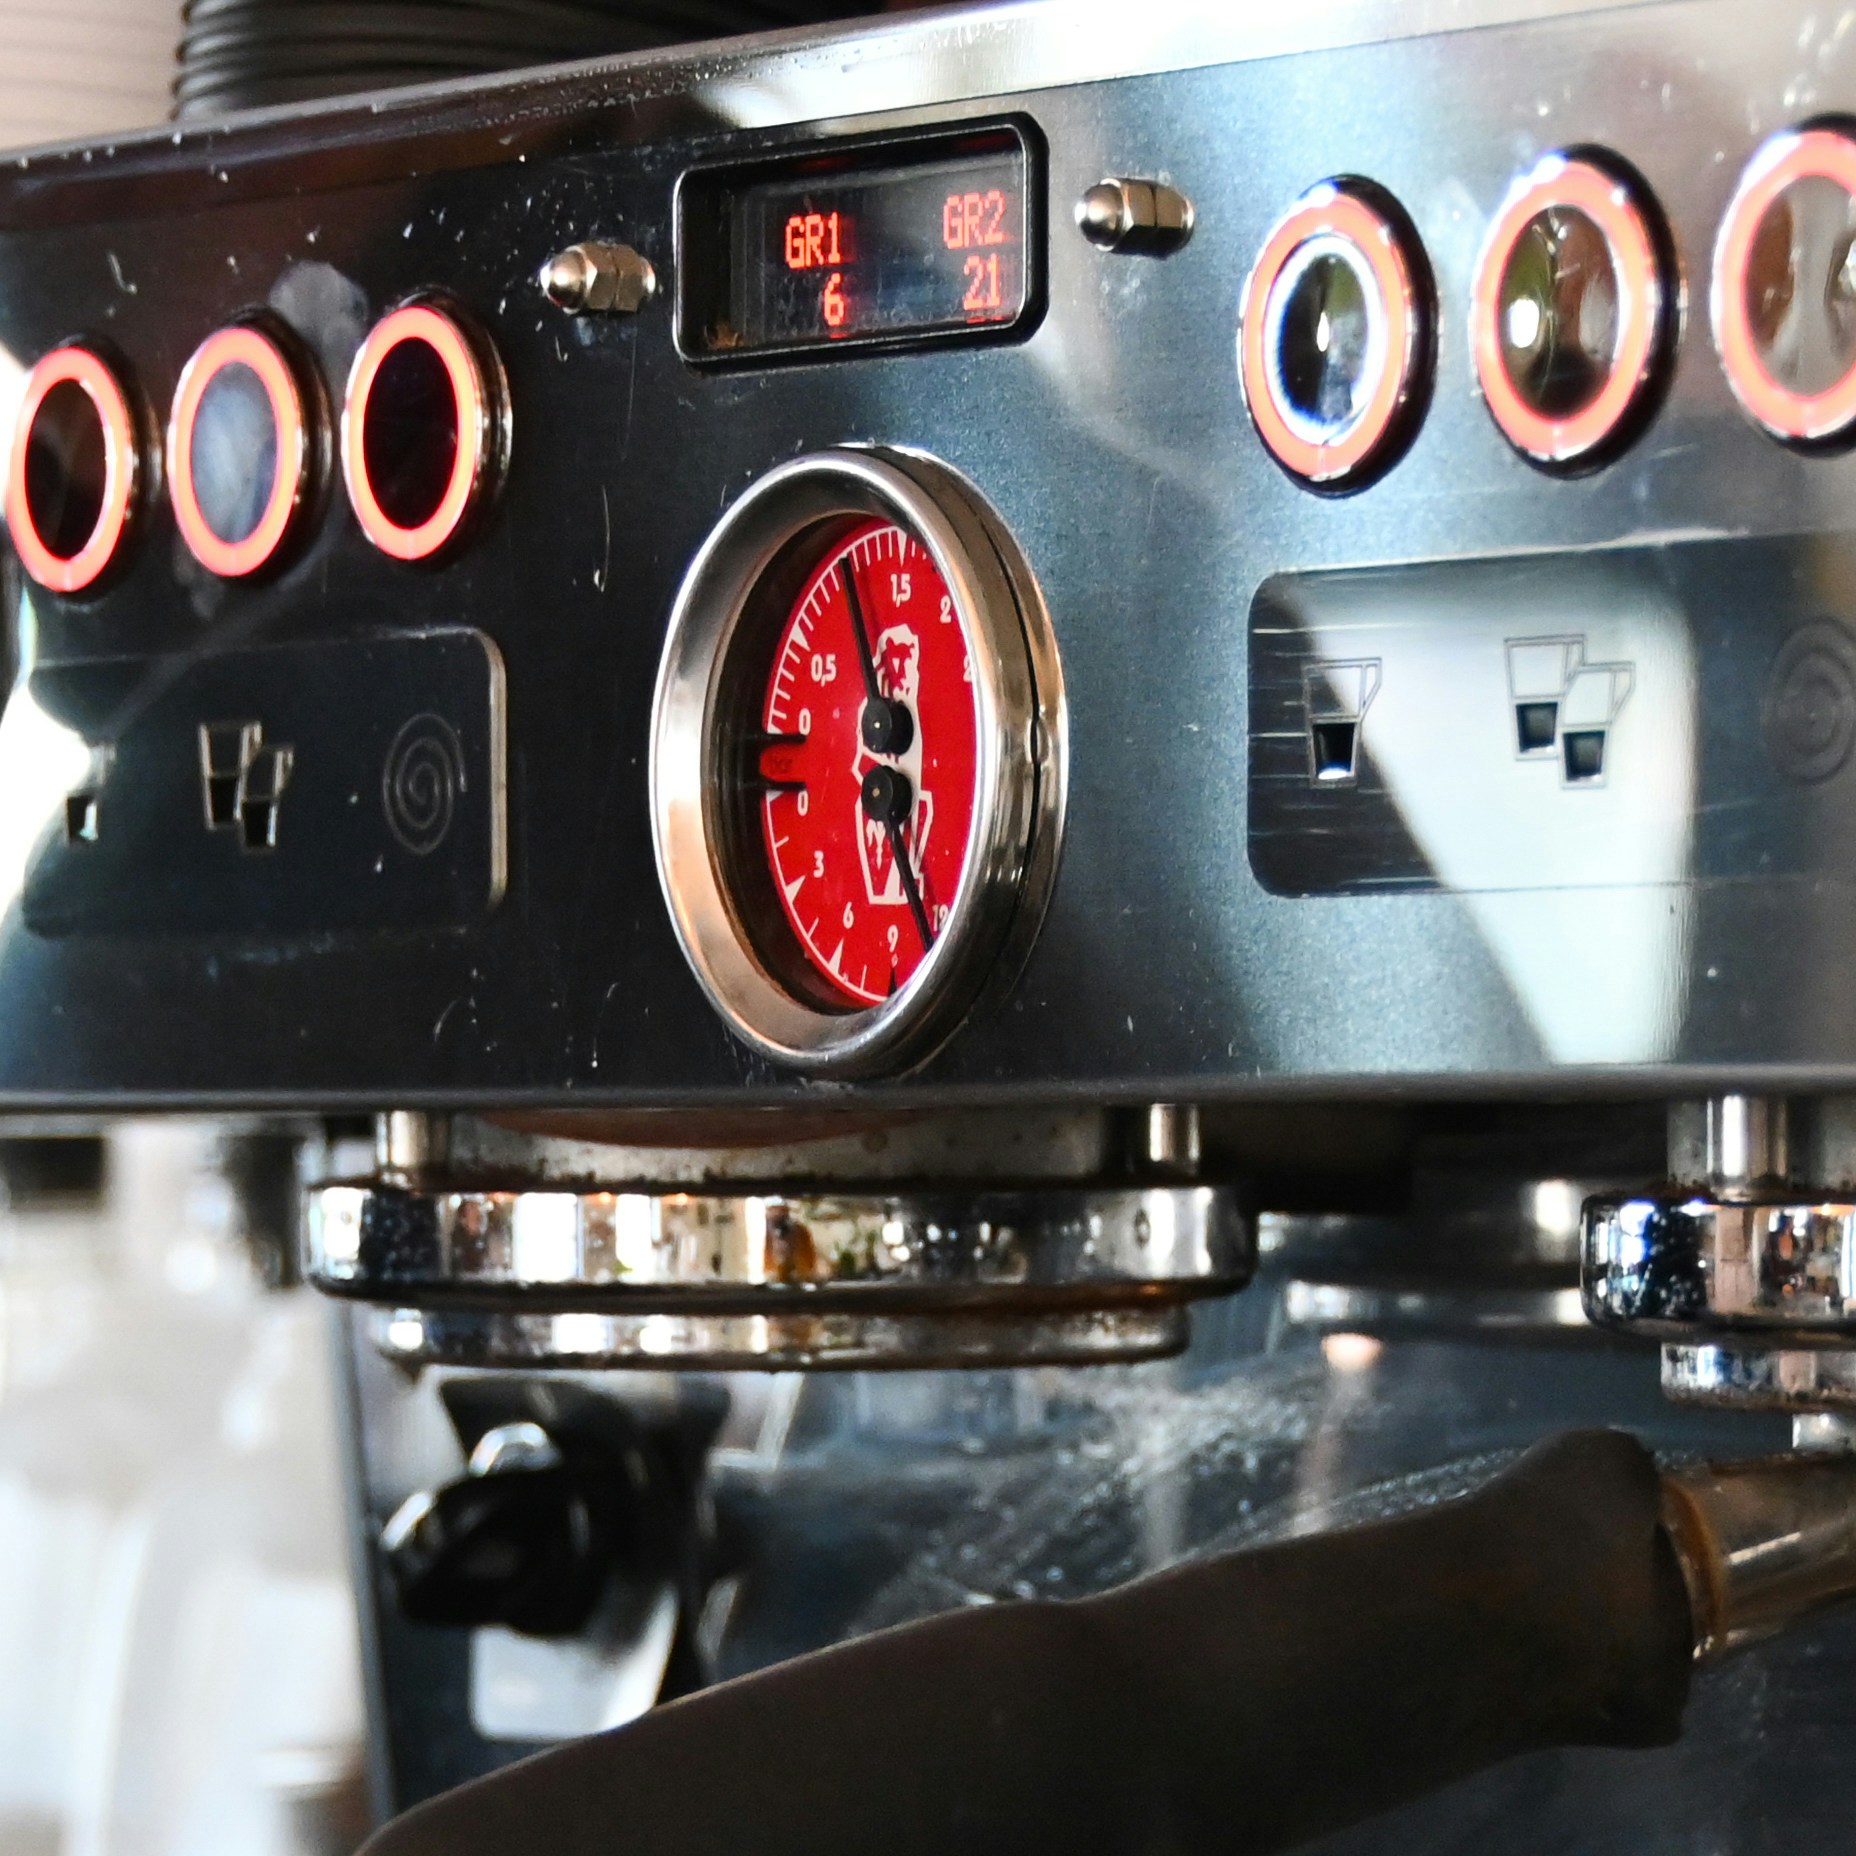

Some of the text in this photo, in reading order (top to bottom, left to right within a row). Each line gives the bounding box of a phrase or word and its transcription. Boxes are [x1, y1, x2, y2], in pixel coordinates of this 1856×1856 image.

[943, 190, 1006, 250] GR2
[784, 211, 842, 270] GR1
[962, 254, 1001, 310] 21
[823, 272, 844, 326] 6
[890, 573, 912, 608] 1,5
[939, 595, 952, 624] 2
[811, 654, 837, 687] 0,5
[798, 708, 811, 736] 0
[797, 790, 809, 816] 0
[813, 850, 825, 878] 3
[842, 901, 855, 929] 6
[887, 924, 899, 953] 9
